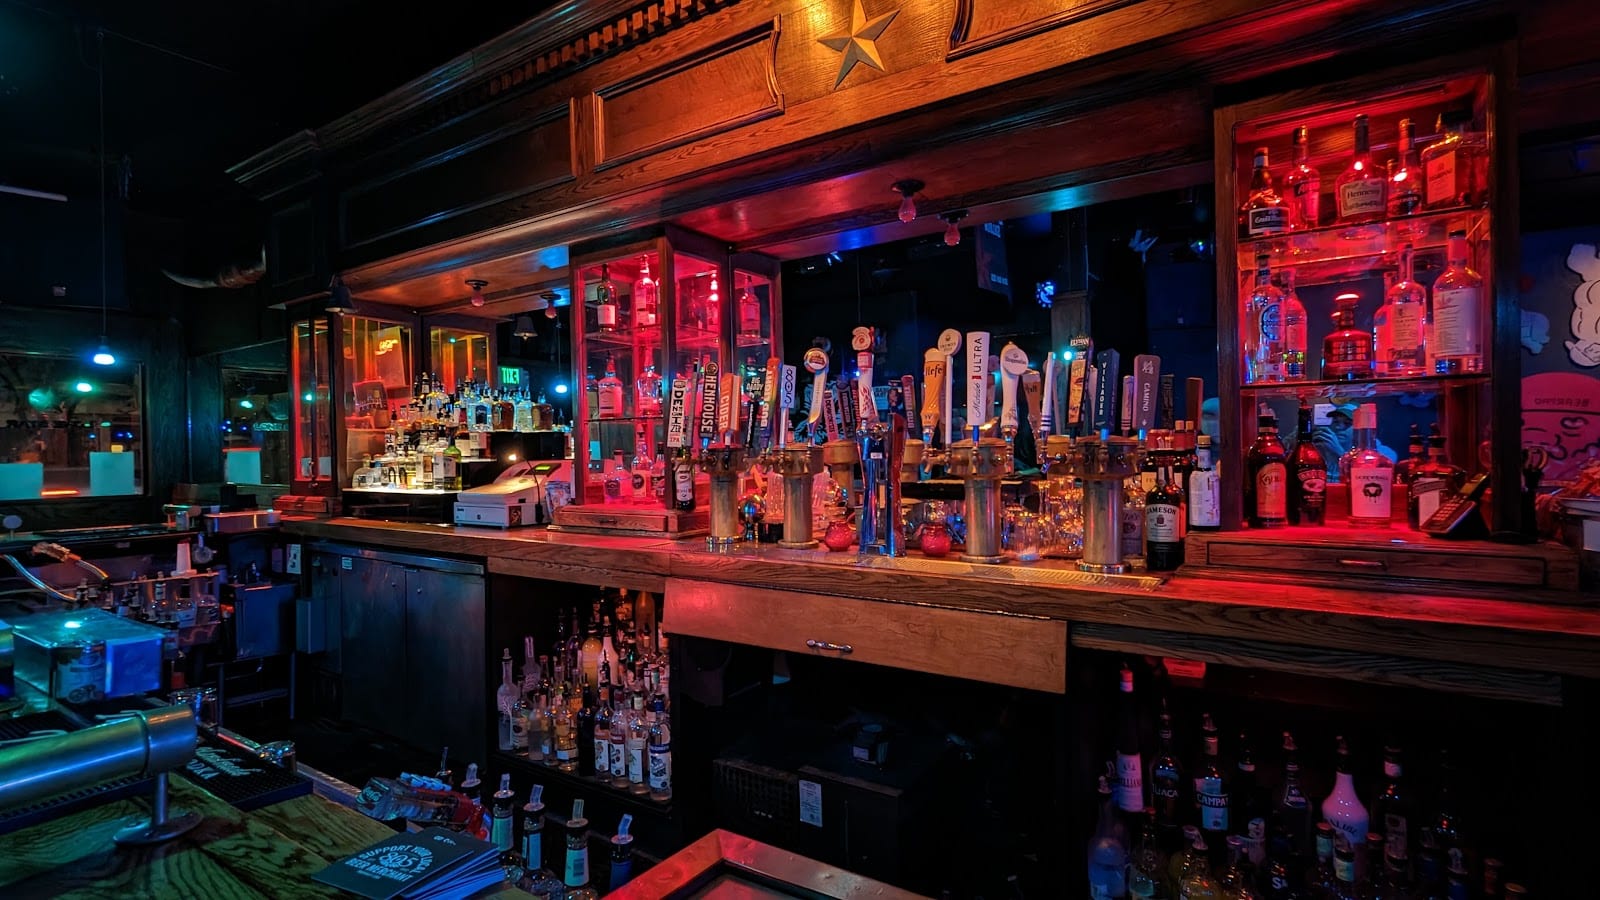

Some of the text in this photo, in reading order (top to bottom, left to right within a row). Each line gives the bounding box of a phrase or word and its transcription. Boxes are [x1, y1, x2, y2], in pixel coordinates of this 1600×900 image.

[1346, 189, 1381, 200] Hennessy
[973, 337, 982, 373] ULTRA
[1098, 362, 1107, 416] VILLAGER
[1143, 383, 1152, 412] CAMINO
[701, 375, 718, 433] HENHOUSE
[719, 395, 731, 431] CIDER
[760, 402, 770, 428] BUD
[1146, 507, 1177, 515] JAMESON
[358, 845, 414, 859] SUPPORT
[379, 851, 419, 868] 805
[345, 858, 371, 869] BEER
[366, 864, 414, 882] MERCHANT
